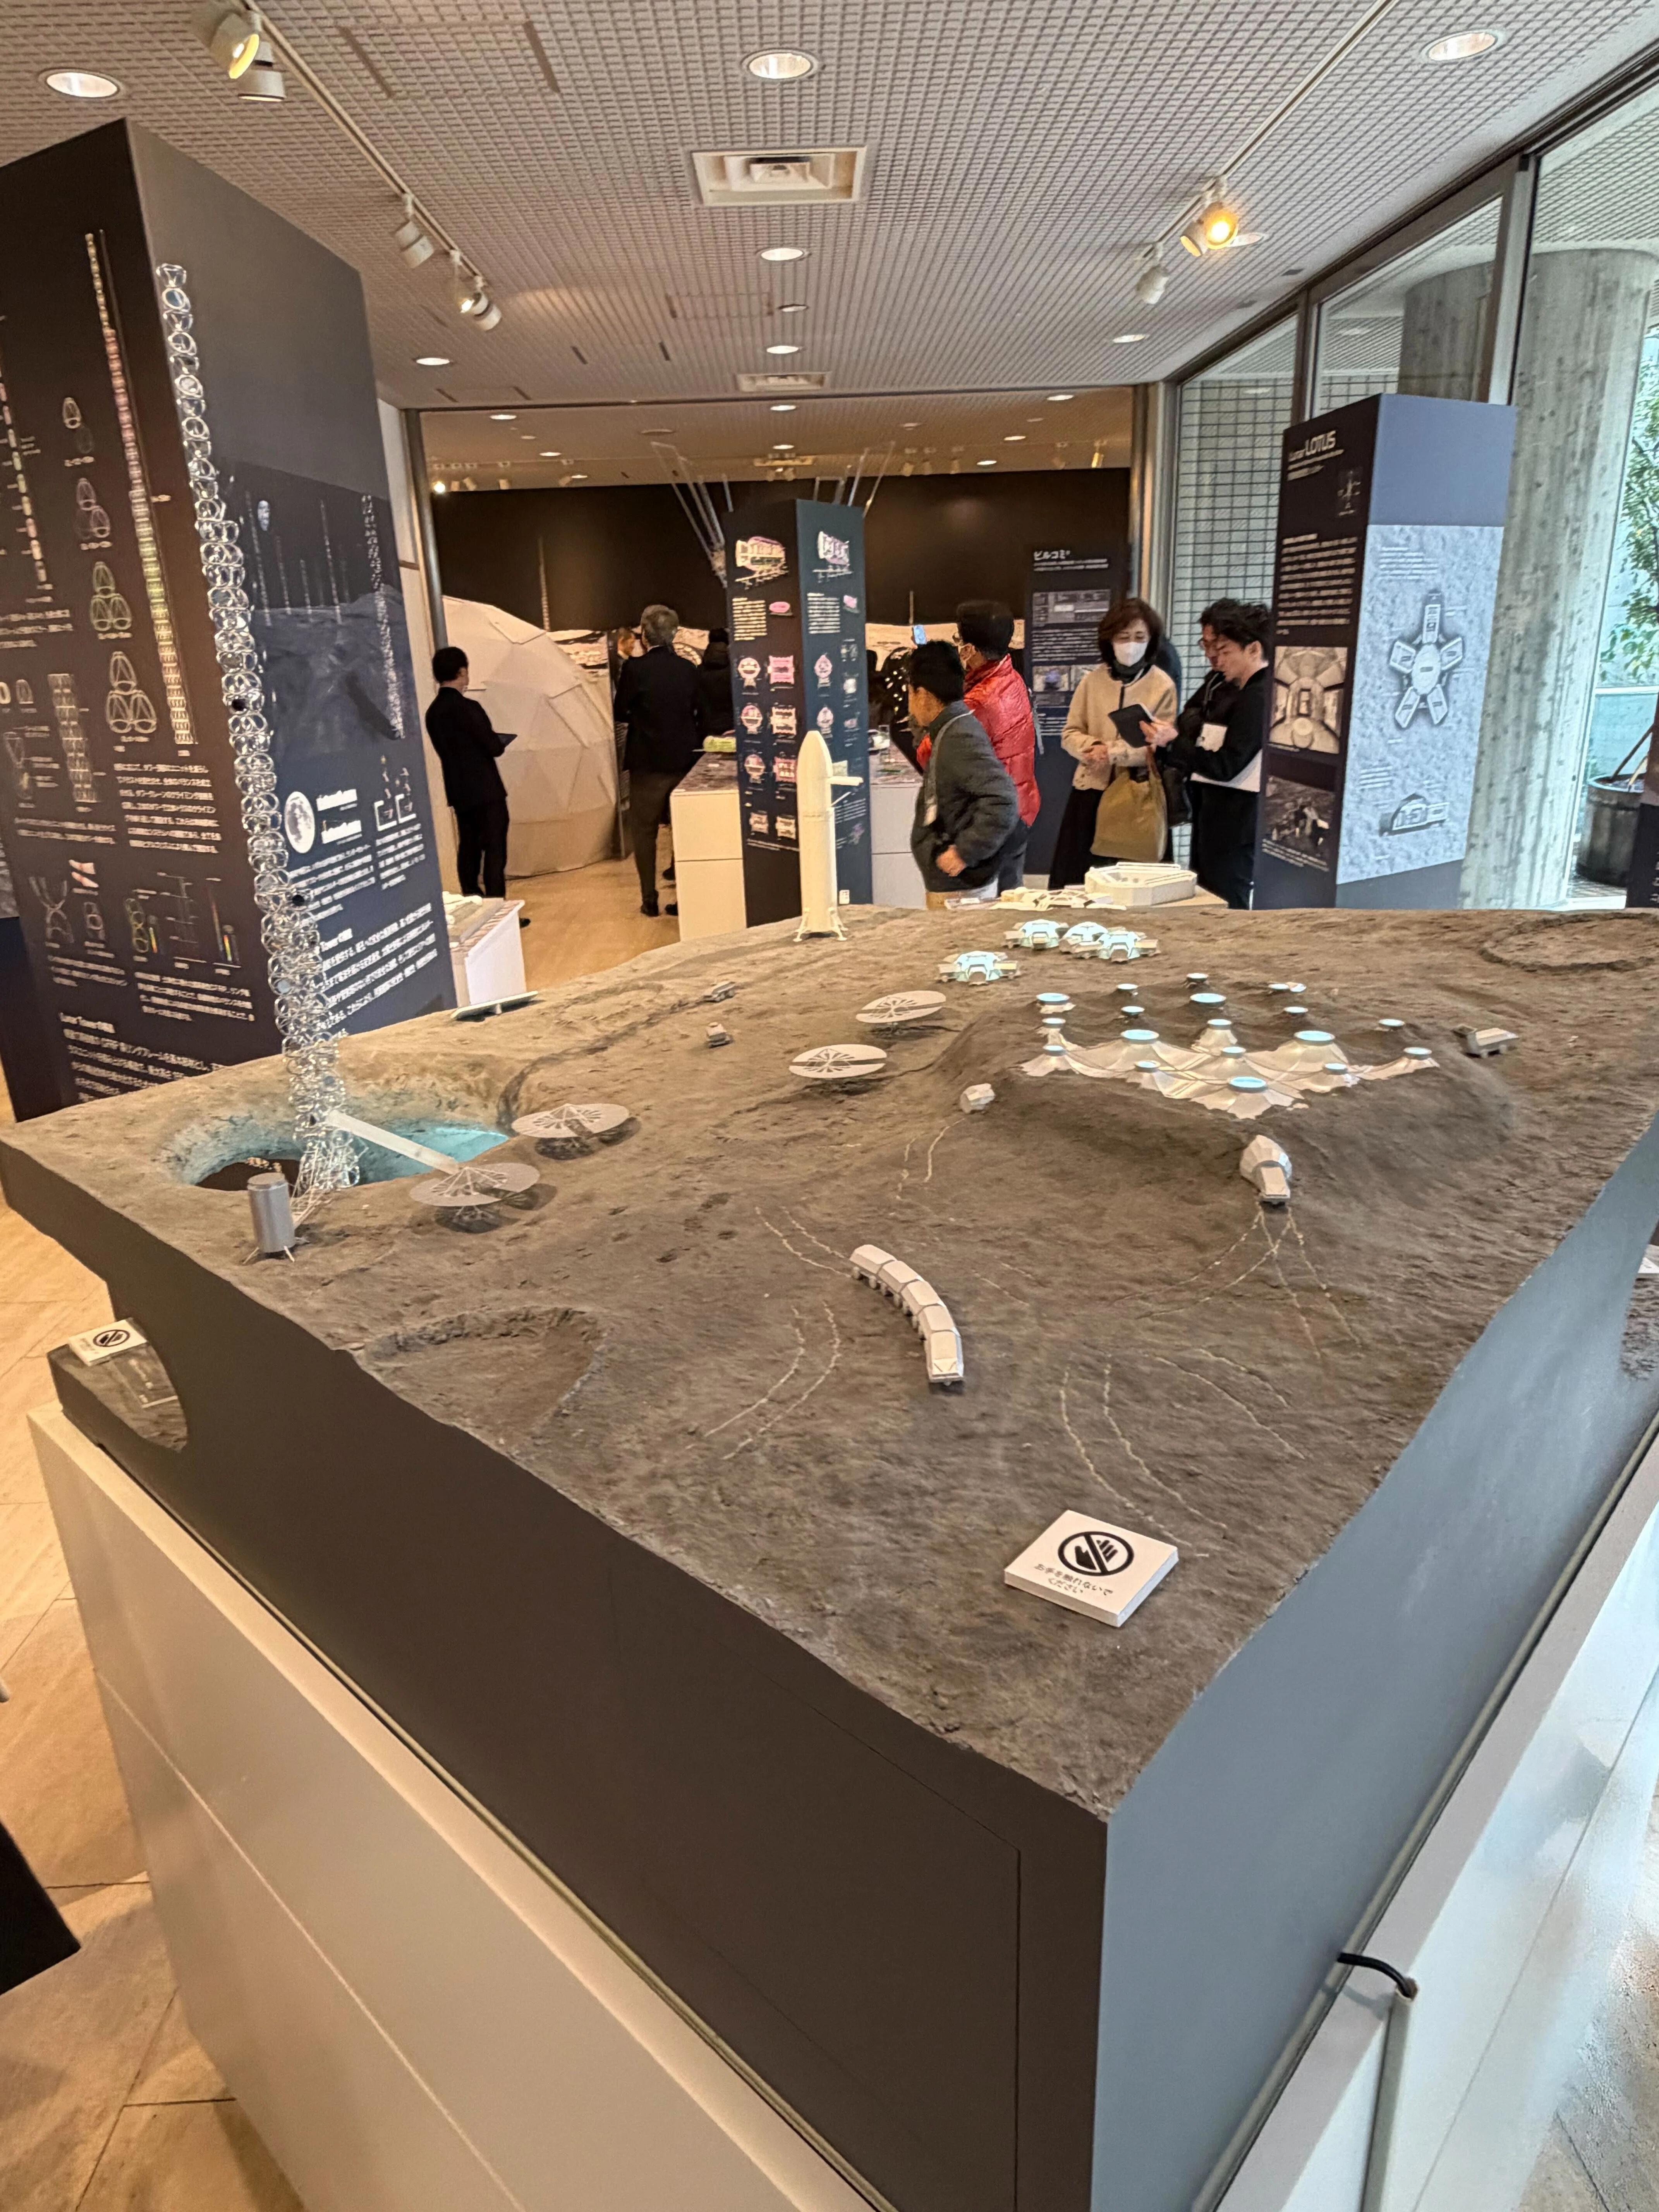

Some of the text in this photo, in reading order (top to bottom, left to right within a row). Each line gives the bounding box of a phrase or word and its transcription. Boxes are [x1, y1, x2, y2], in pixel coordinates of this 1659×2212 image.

[1034, 1563, 1113, 1595] お手を触れないで
[1048, 1577, 1084, 1593] ください
